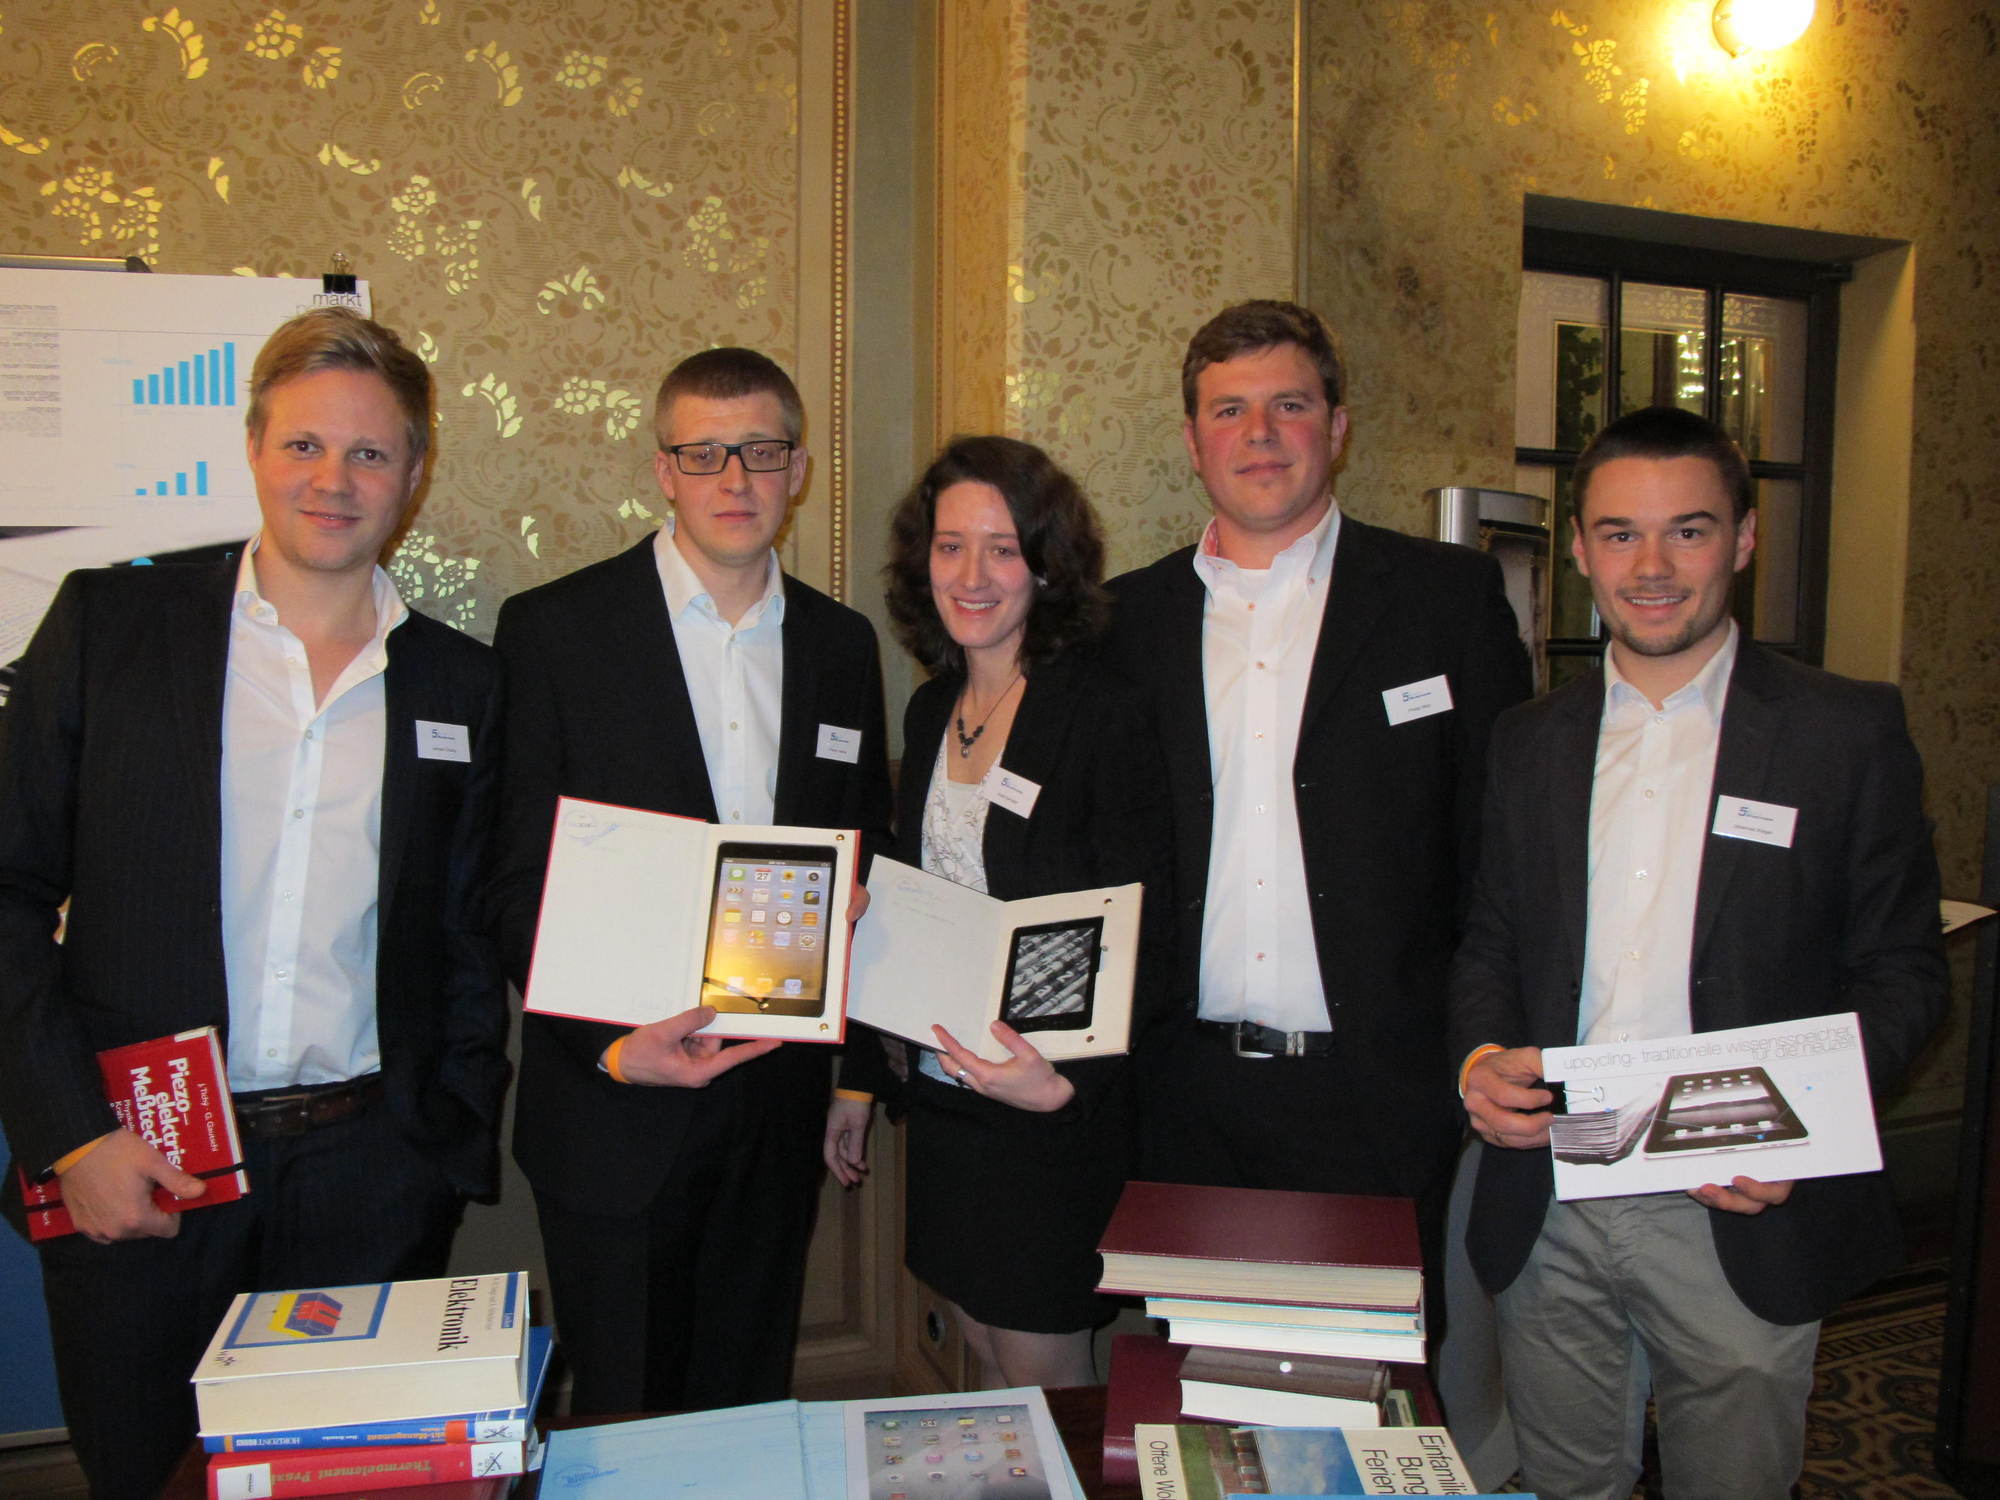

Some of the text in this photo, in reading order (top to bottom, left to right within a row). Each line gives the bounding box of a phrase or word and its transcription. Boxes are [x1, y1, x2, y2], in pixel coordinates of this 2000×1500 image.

[312, 292, 362, 307] markt
[756, 872, 769, 881] 27
[437, 1278, 479, 1352] Elektronik
[318, 1460, 432, 1480] Thermoelement
[1149, 1440, 1177, 1500] Offene Wo
[1361, 1449, 1397, 1494] Ferien
[1396, 1456, 1429, 1495] Bung
